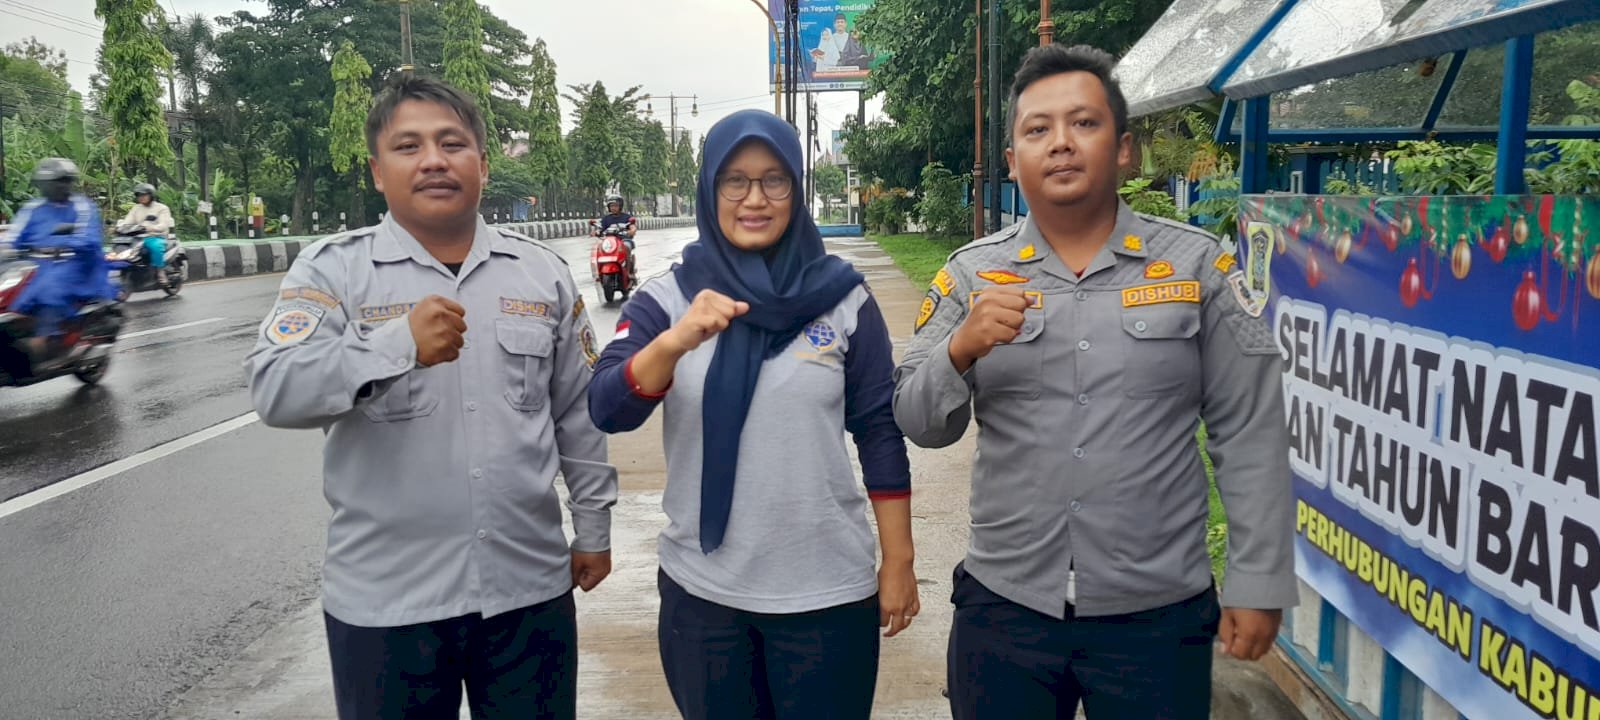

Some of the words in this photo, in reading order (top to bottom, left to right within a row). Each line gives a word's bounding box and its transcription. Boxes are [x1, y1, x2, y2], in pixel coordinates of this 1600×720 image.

[835, 3, 875, 12] Pendidik
[503, 299, 546, 315] DISHUB
[1127, 285, 1194, 303] DISHUB
[1279, 311, 1441, 429] SELAMAT
[1452, 358, 1600, 499] NATA
[1333, 413, 1461, 550] TAHUN
[1476, 478, 1600, 632] BAR
[1296, 498, 1472, 657] PERHUBUNGAN
[1480, 623, 1600, 720] KABU
